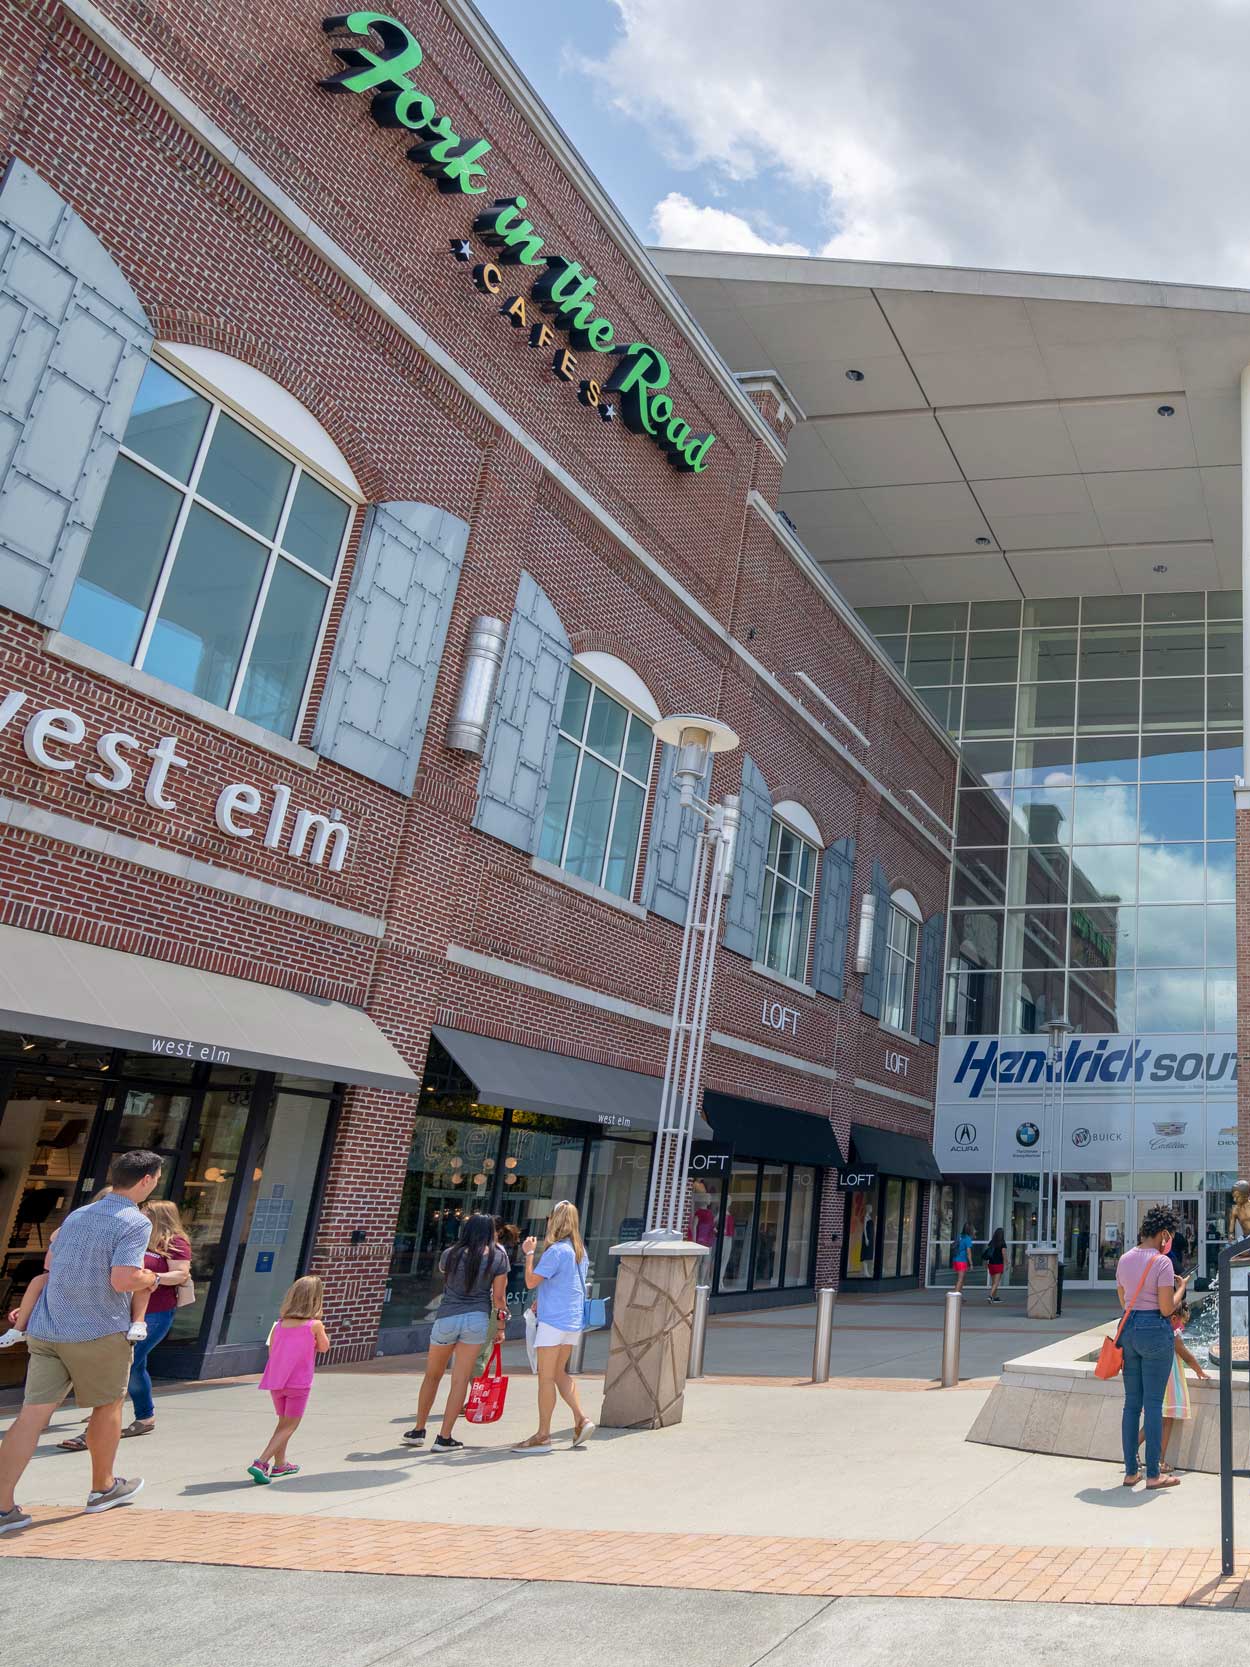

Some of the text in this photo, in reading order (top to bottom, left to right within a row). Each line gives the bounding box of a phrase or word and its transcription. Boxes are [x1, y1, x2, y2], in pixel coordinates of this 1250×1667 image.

[335, 11, 717, 474] Fork in the Road
[481, 262, 601, 408] CAFES
[0, 691, 351, 872] est elm
[761, 999, 801, 1036] LOFT
[152, 1038, 231, 1063] west elm
[884, 1049, 910, 1077] LOFT
[953, 1039, 1153, 1098] Hendrick
[598, 1114, 631, 1128] west elm
[1092, 1133, 1122, 1141] BUICK
[840, 1174, 875, 1186] LOFT
[506, 1288, 528, 1306] est
